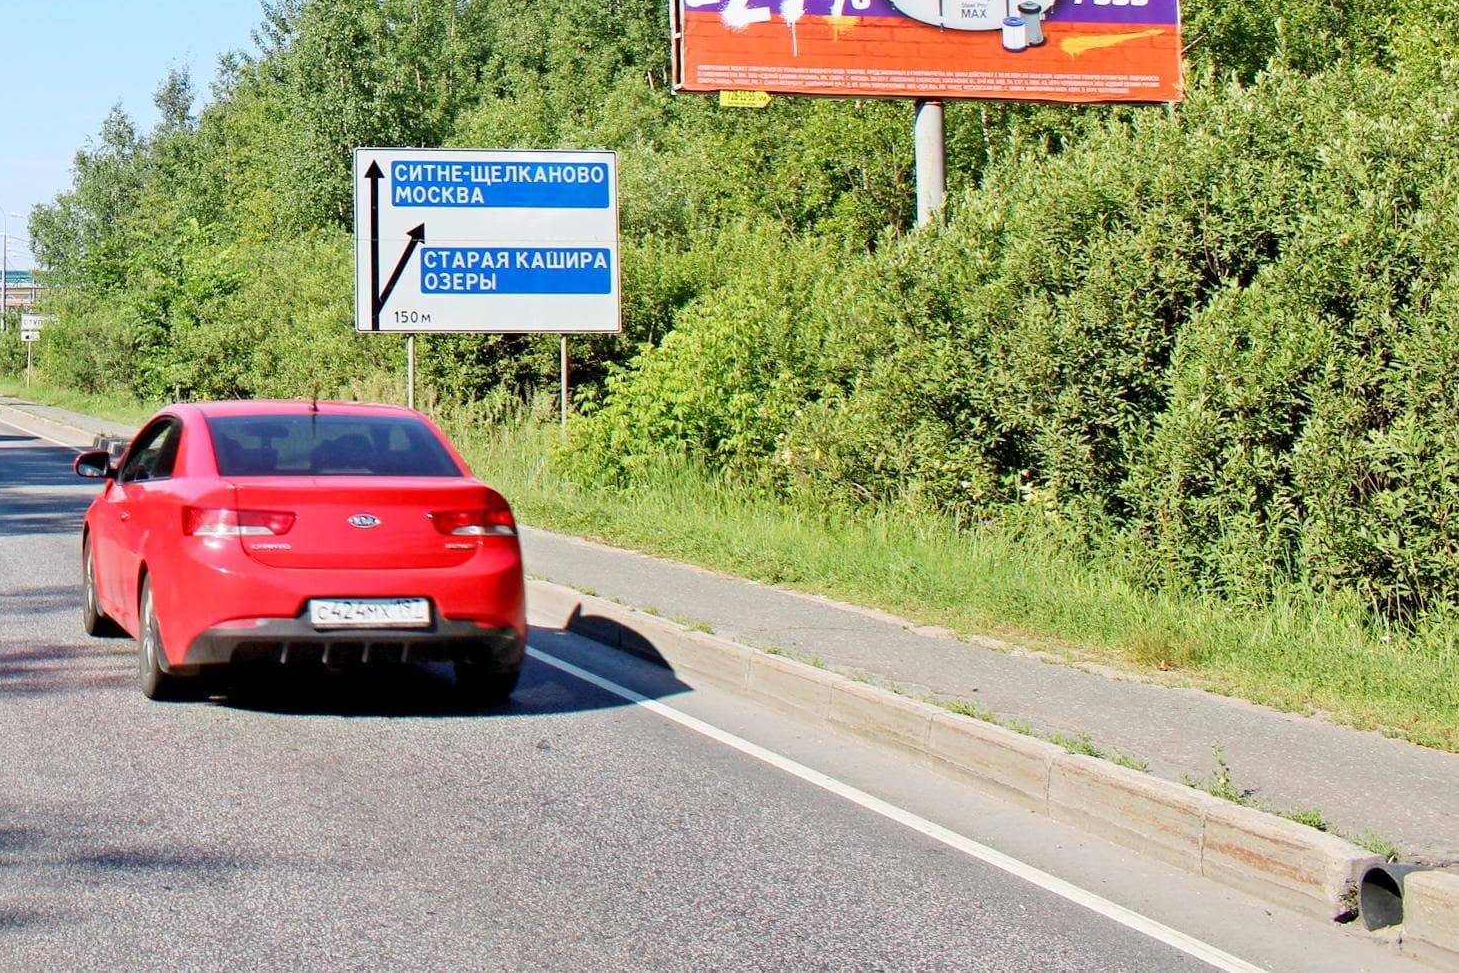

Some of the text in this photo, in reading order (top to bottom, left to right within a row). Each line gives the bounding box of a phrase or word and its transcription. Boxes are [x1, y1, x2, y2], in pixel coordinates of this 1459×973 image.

[961, 9, 987, 18] MAX
[394, 164, 604, 185] СИТНЕ-ЩЕЛКАНОВО
[395, 186, 484, 204] МОСКВА
[424, 251, 607, 269] СТАРАЯ КАШИРА
[425, 273, 496, 290] ОЗЕРЫ
[394, 311, 431, 323] 150 м
